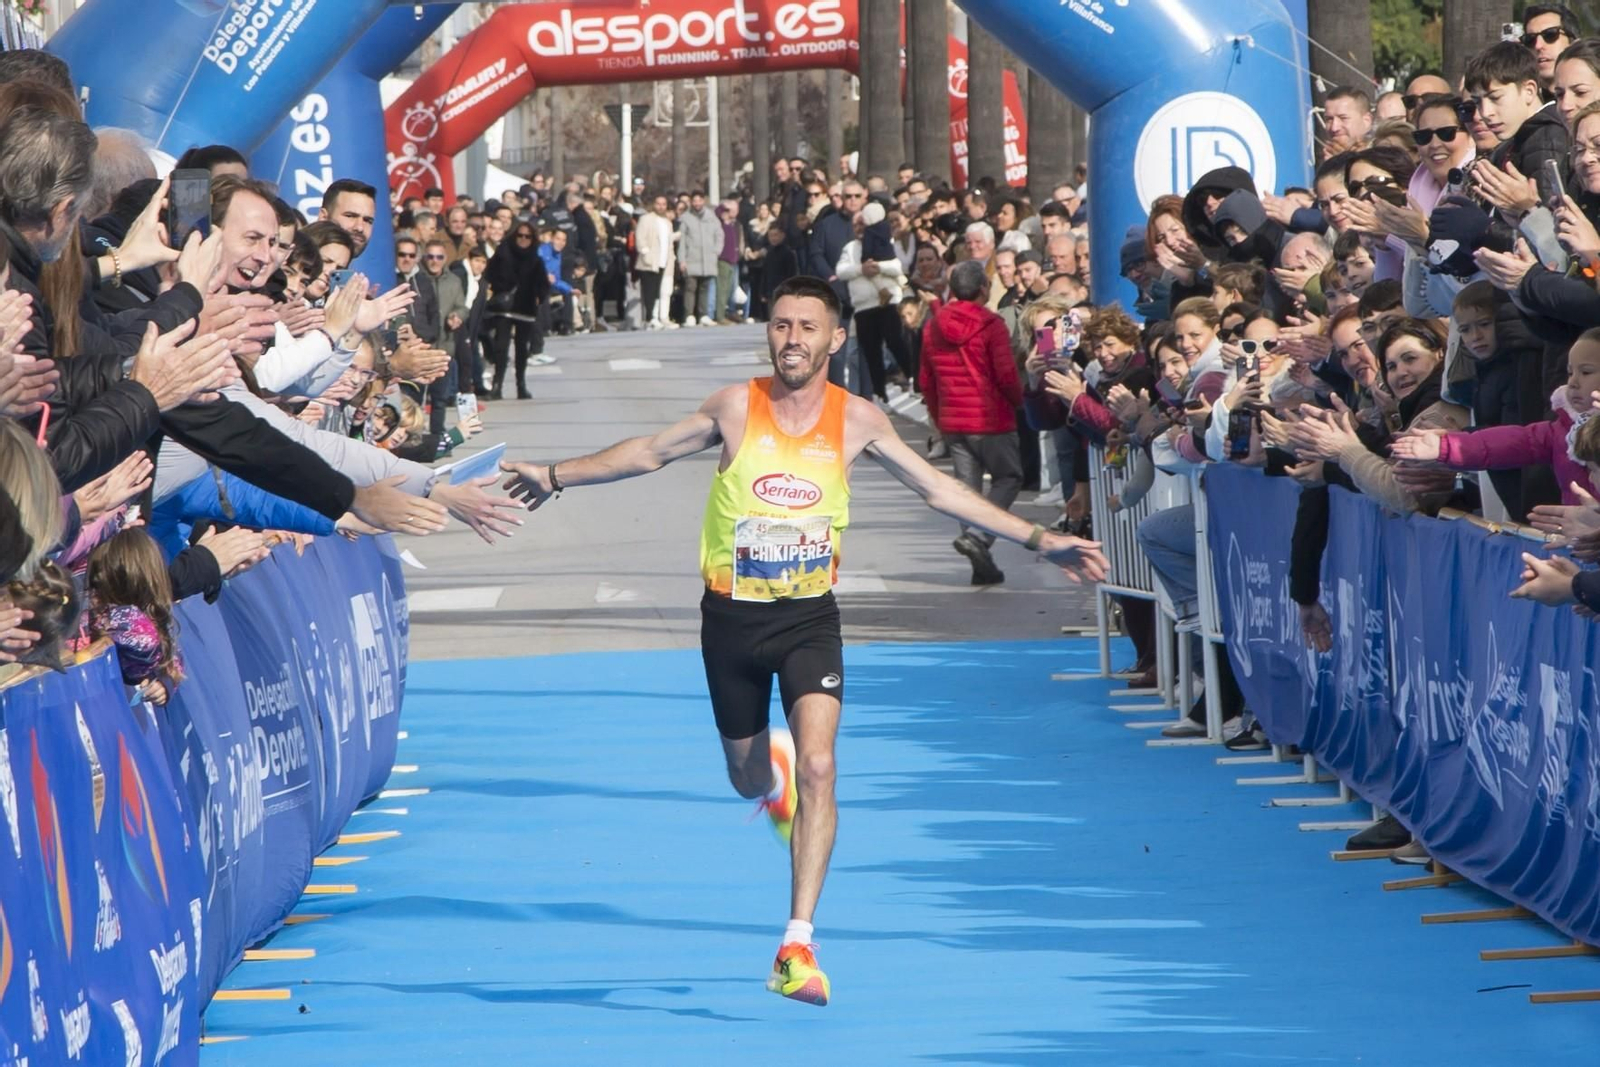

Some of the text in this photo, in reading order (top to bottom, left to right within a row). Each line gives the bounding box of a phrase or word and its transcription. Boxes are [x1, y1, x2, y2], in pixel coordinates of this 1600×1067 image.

[527, 0, 845, 66] alssport.es
[255, 40, 285, 75] Palacios
[597, 39, 847, 69] TIENDA RUNNING TRAIL OUTDOOR
[434, 57, 507, 110] YOMURY
[759, 480, 817, 502] Serrano
[756, 523, 769, 534] 45
